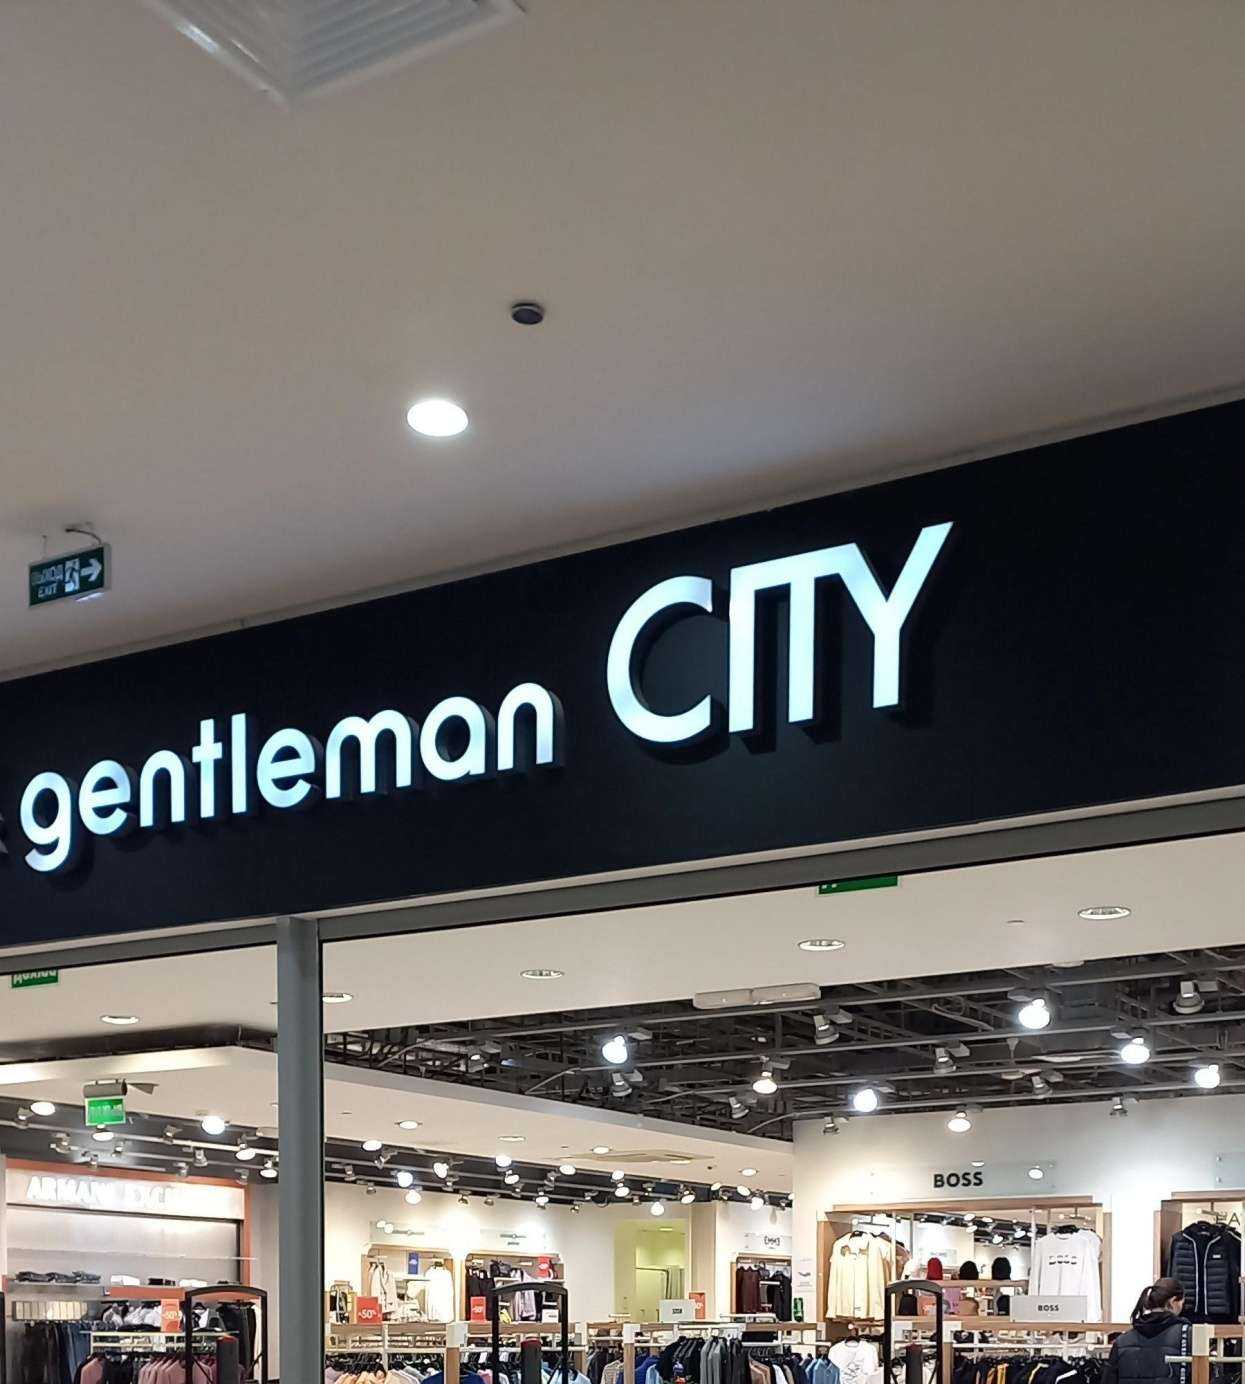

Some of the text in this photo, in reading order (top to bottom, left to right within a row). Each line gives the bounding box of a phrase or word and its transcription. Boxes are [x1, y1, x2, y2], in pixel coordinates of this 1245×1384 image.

[20, 521, 954, 872] gentleman CITY
[933, 1171, 984, 1188] BOSS
[1037, 1304, 1059, 1312] BOSS
